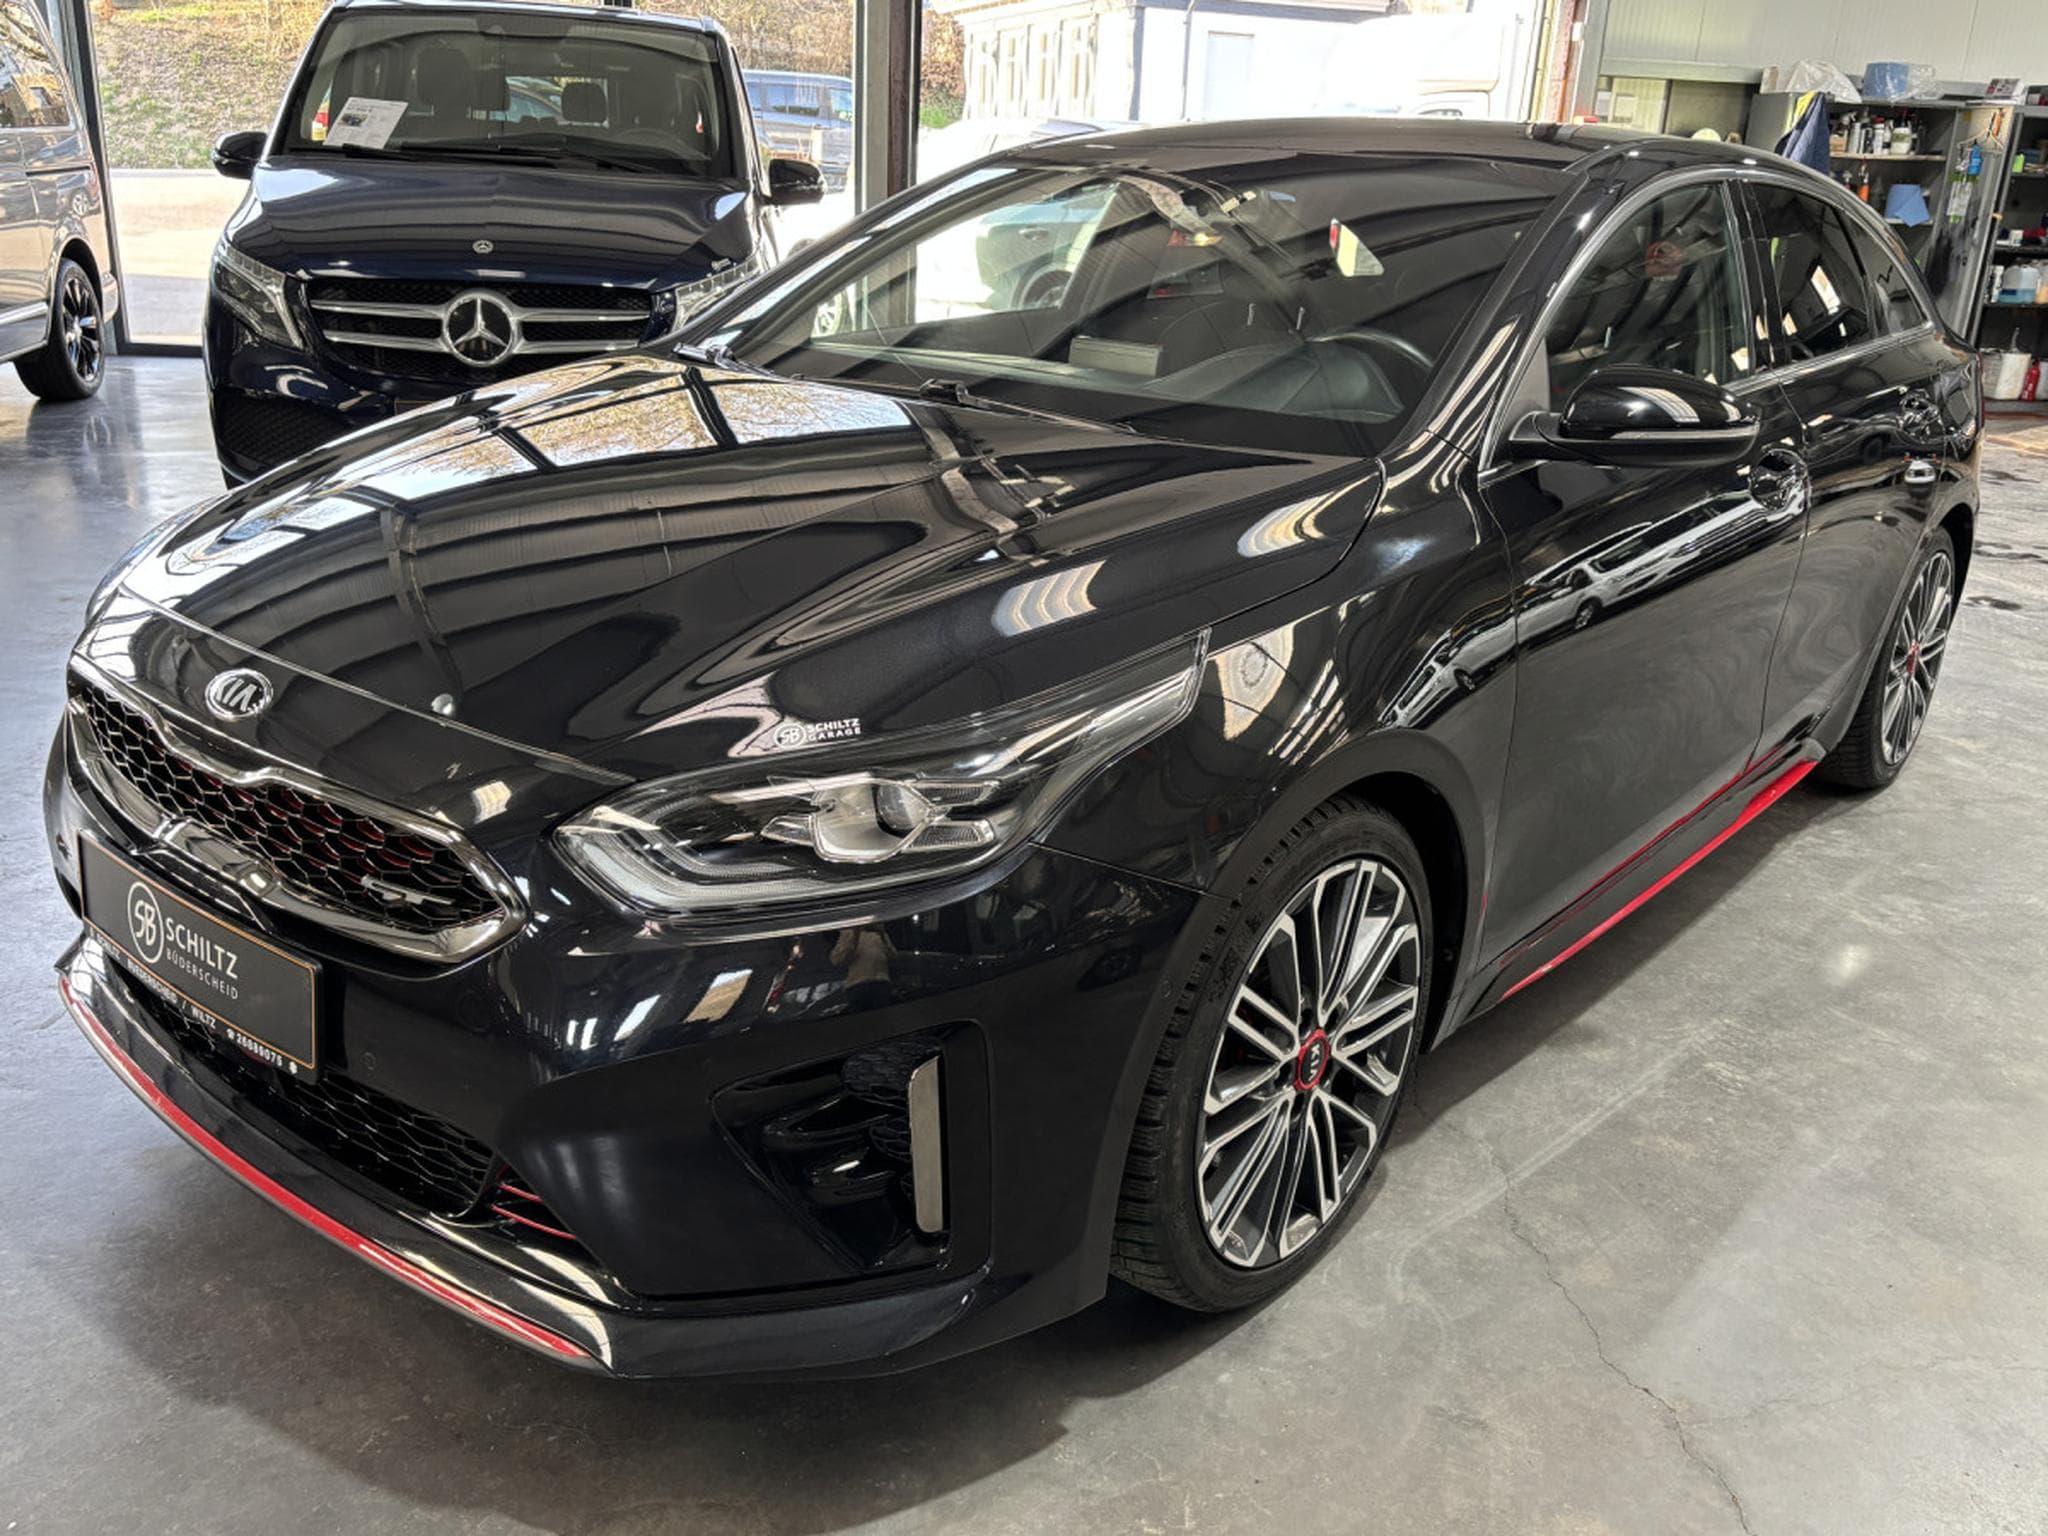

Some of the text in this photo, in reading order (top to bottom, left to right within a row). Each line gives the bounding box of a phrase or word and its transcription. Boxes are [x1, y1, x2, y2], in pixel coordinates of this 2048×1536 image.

[806, 718, 860, 733] SCHILTZ
[808, 727, 862, 742] GARAGE
[165, 917, 239, 980] SCHILTZ
[165, 947, 239, 1000] BÜDERSCHEID
[1309, 1043, 1321, 1082] KIA
